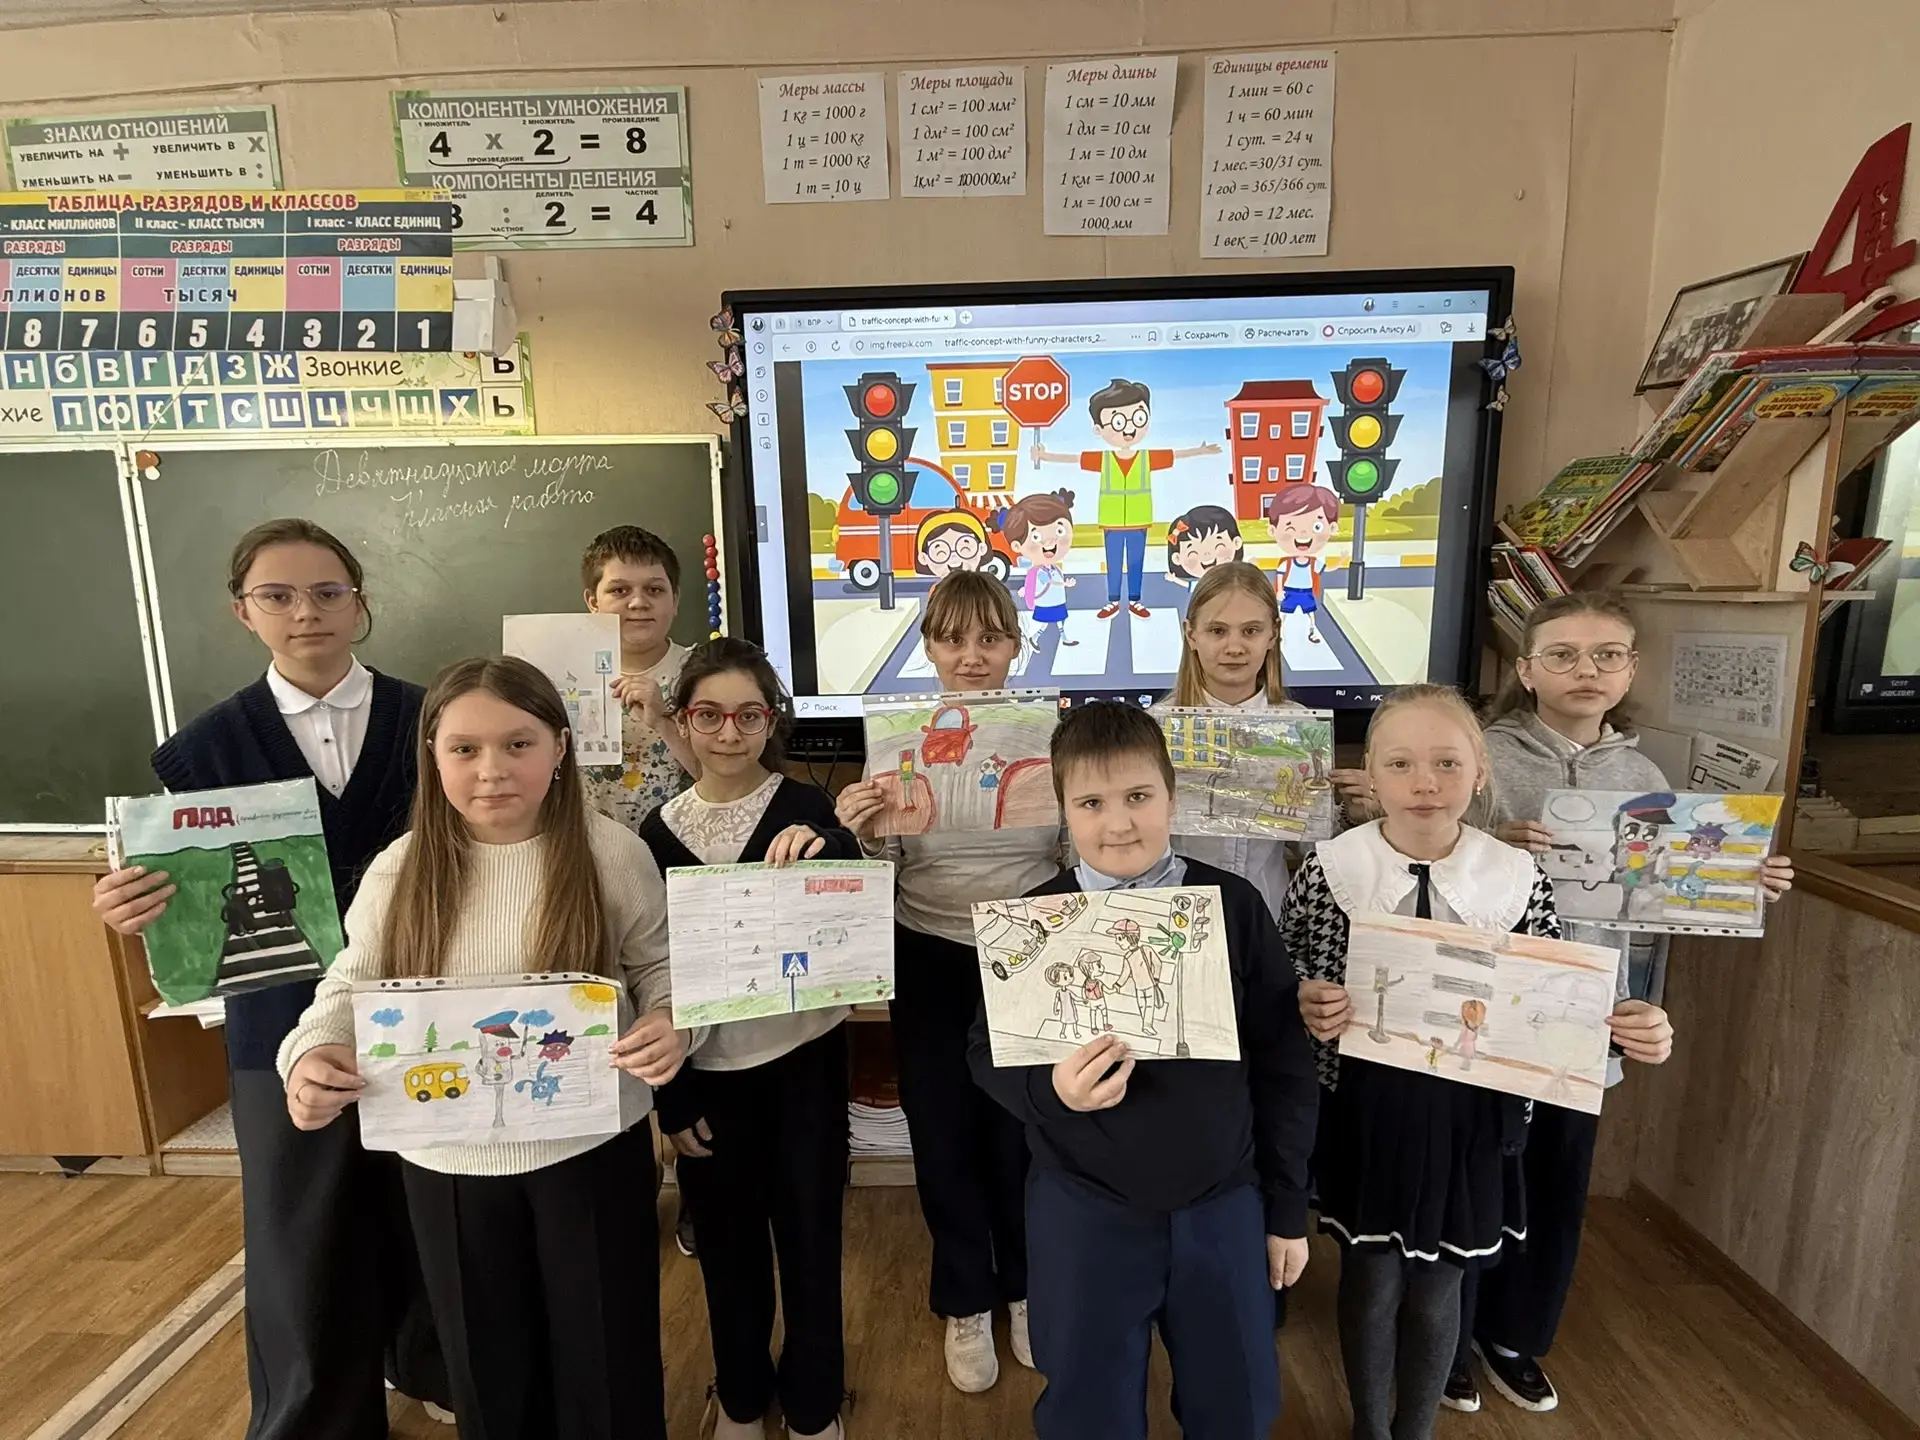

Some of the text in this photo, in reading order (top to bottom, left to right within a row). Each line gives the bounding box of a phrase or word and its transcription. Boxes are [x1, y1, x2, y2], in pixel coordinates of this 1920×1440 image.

[1213, 60, 1328, 75] Единицы времени
[1067, 64, 1157, 86] Меры длины
[911, 71, 1013, 94] Меры площади
[779, 82, 865, 100] Меры массы
[1228, 83, 1312, 98] 1 мин 60 с
[910, 103, 916, 115] 1
[961, 99, 985, 112] 100
[1065, 94, 1155, 108] 1 см 10 мм
[408, 98, 668, 119] КОМПОНЕНТЫ УМНОЖЕНИЯ
[782, 109, 788, 122] 1
[793, 110, 807, 124] кг
[825, 106, 856, 119] 1000
[1226, 108, 1312, 124] 1 ч 60 мин
[44, 115, 229, 143] ЗНАКИ ОТНОШЕНИЙ
[913, 127, 919, 140] 1
[965, 125, 988, 138] 100
[1067, 120, 1150, 136] 1 дм 10 см
[429, 127, 647, 157] 4 2 8
[787, 131, 864, 149] 1 ц 100 кг
[1226, 131, 1312, 151] 1 сут. 24 ч
[153, 141, 235, 154] УВЕЛИЧИТЬ В
[20, 149, 104, 162] УВЕЛИЧИТЬ НА
[156, 167, 246, 180] УМЕНЬШИТЬ В
[432, 171, 657, 190] КОМПОНЕНТЫ ДЕЛЕНИЯ
[22, 175, 114, 187] УМЕНЬШИТЬ НА
[1206, 179, 1327, 196] 1 год 365/366 сут.
[47, 194, 357, 212] ТАБЛИЦА РАЗРЯДОВ И КЛАССОВ
[545, 200, 658, 227] 2 4
[11, 217, 116, 230] КЛАСС МИЛЛИОНОВ
[146, 220, 178, 229] класс
[188, 217, 225, 229] КЛАСС
[226, 218, 264, 230] ТЫСЯЧ
[314, 218, 345, 228] класс
[356, 216, 392, 228] КЛАСС
[394, 216, 440, 229] ЕДИНИЦ
[4, 240, 65, 253] РАЗРЯДЫ
[172, 240, 232, 253] РАЗРЯДЫ
[338, 238, 400, 252] РАЗРЯДЫ
[16, 266, 60, 276] ДЕСЯТКИ
[68, 266, 117, 276] ЕДИНИЦЫ
[132, 266, 164, 276] СОТНИ
[182, 266, 226, 276] ДЕСЯТКИ
[234, 266, 284, 276] ЕДИНИЦЫ
[298, 265, 330, 275] СОТНИ
[347, 265, 392, 276] ДЕСЯТКИ
[400, 265, 451, 275] ЕДИНИЦЫ
[164, 289, 237, 302] ТЫСЯЧ
[24, 318, 430, 348] 8 7 6 5 4 3 2 1
[1185, 330, 1229, 340] Сохранить
[1258, 328, 1308, 338] Распечатать
[1338, 326, 1377, 336] Спросить
[1380, 325, 1404, 335] Алису
[869, 339, 932, 350] img.freepik.com
[306, 358, 403, 377] Звонкие
[1009, 382, 1062, 401] STOP
[173, 807, 235, 829] ПДД
